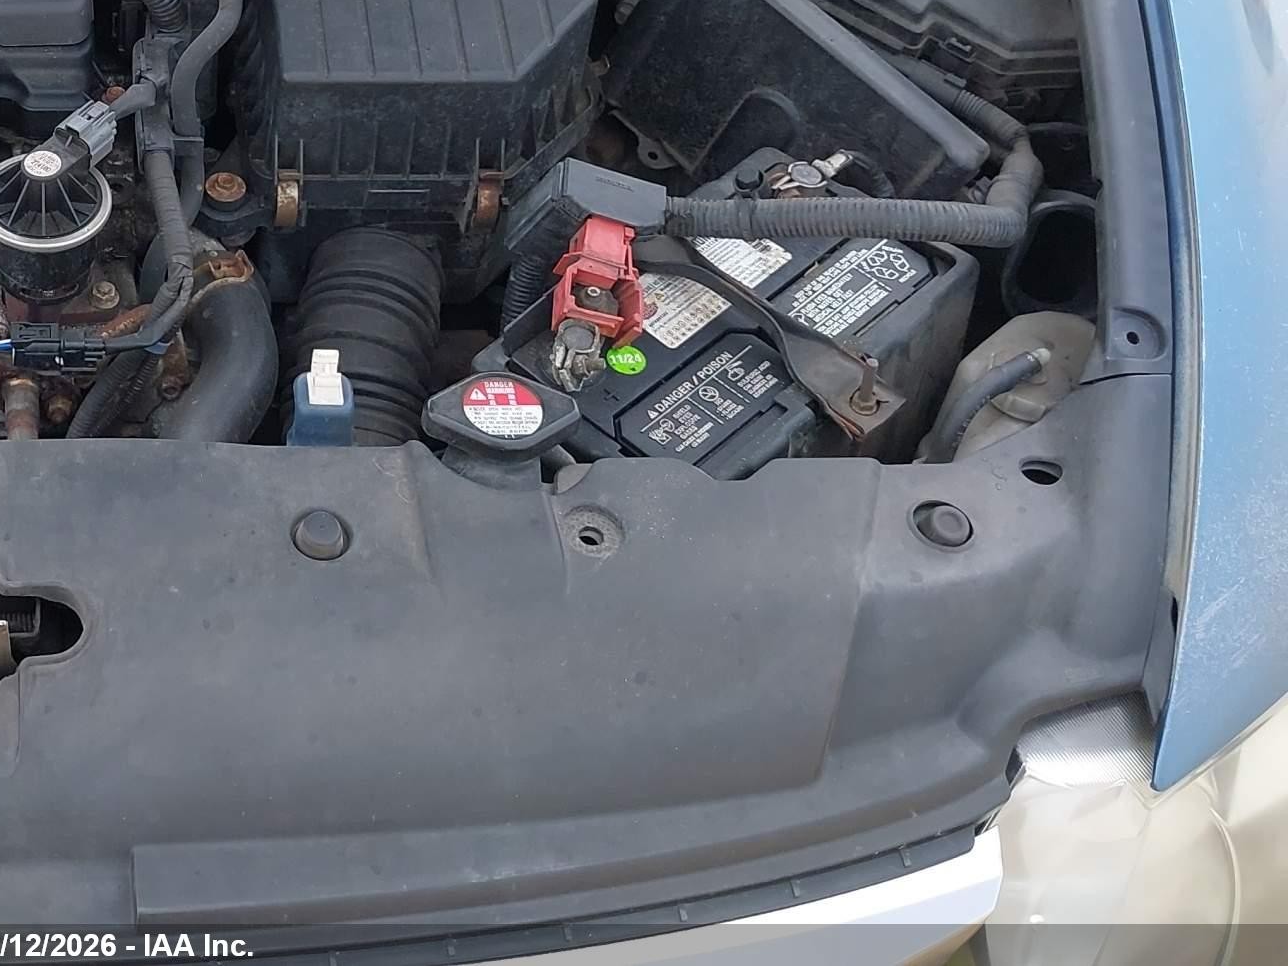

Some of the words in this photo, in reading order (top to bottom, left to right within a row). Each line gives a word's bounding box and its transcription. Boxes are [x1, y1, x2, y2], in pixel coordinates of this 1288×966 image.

[609, 353, 642, 364] 11/24
[653, 380, 695, 413] DANGER
[695, 350, 733, 380] POISON
[671, 403, 691, 419] SHIELD
